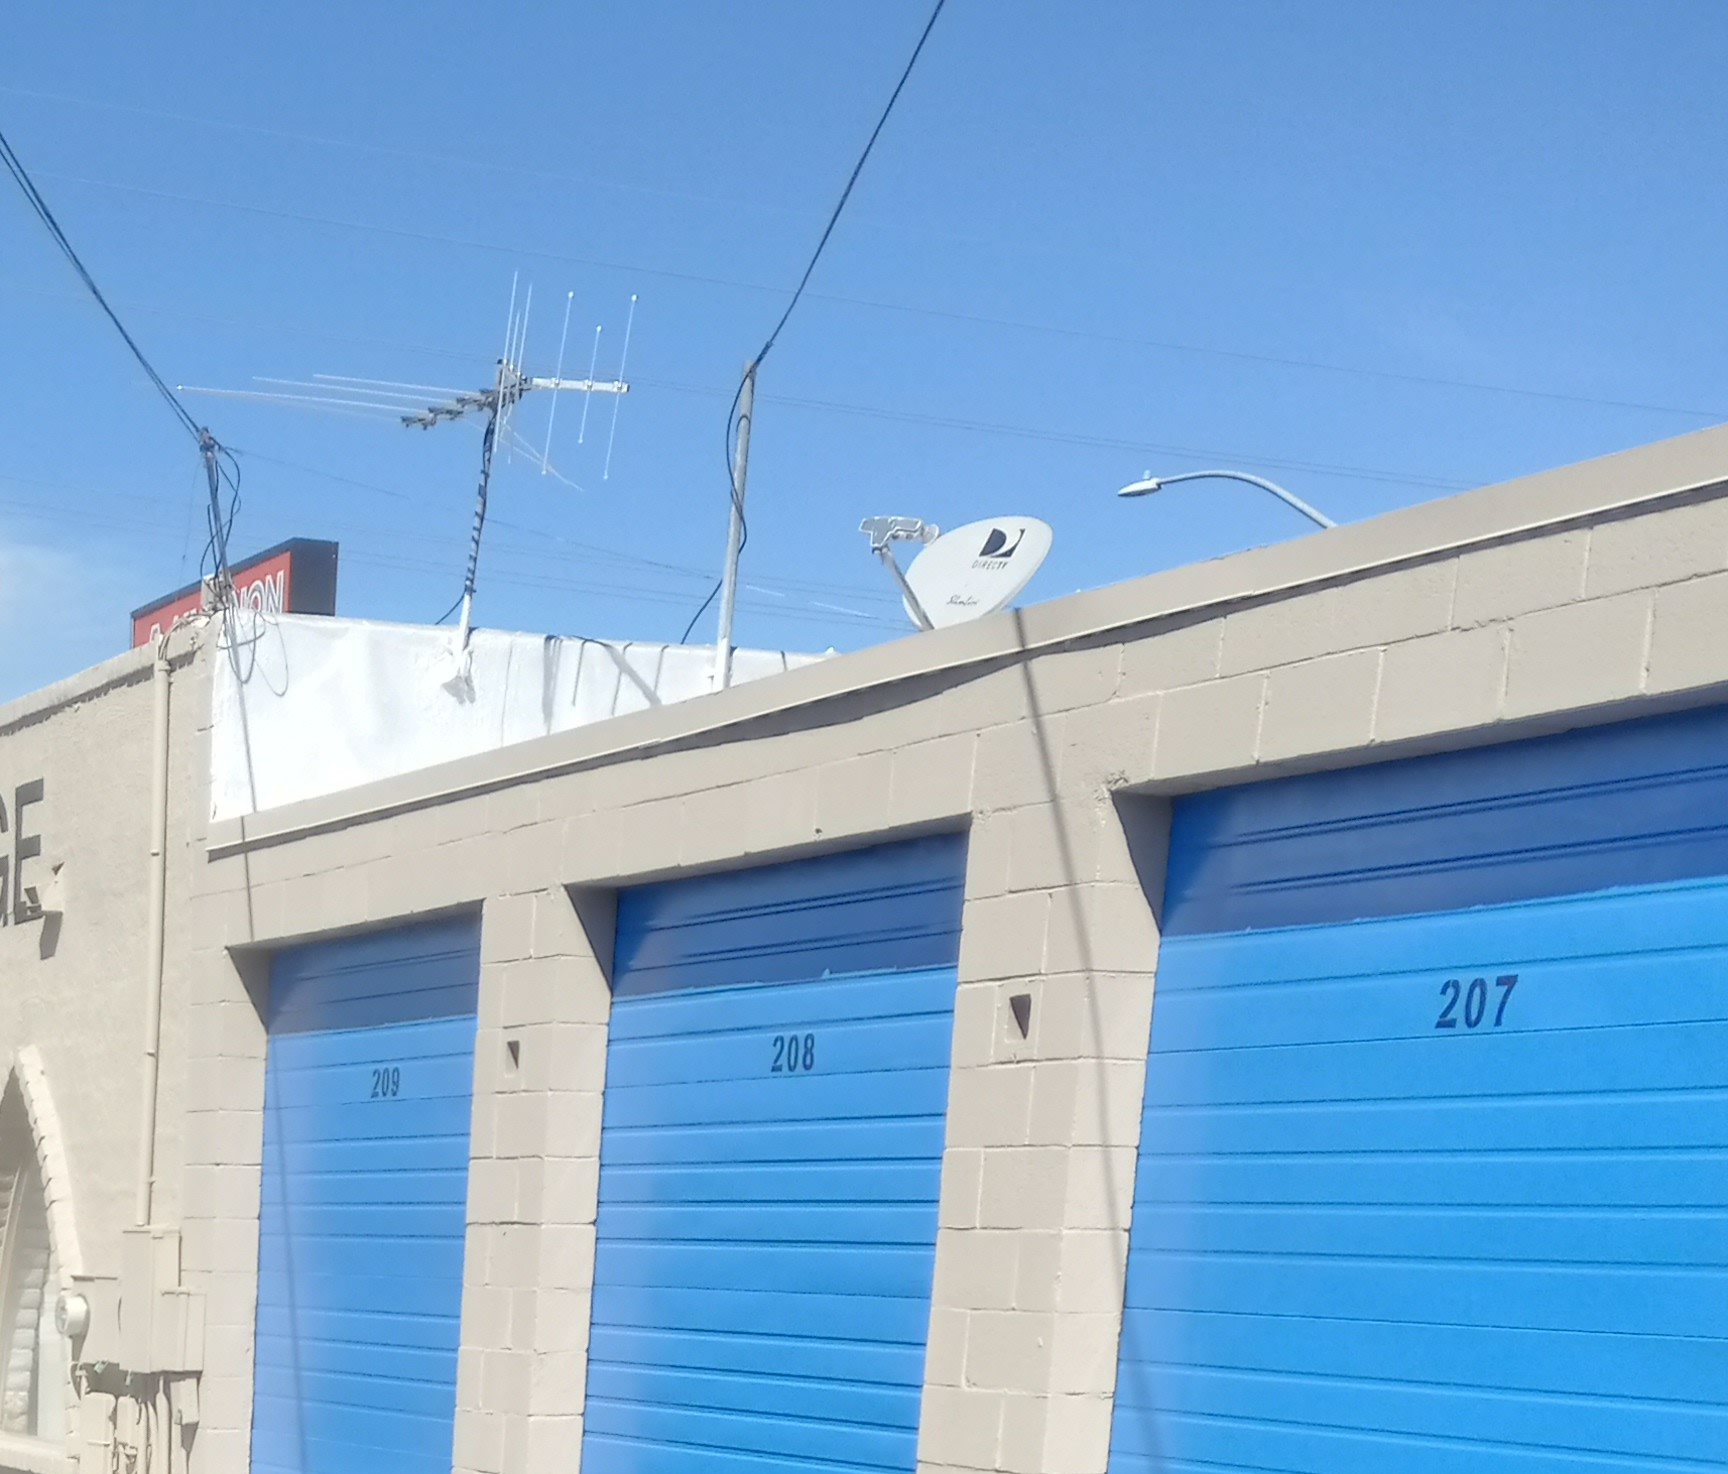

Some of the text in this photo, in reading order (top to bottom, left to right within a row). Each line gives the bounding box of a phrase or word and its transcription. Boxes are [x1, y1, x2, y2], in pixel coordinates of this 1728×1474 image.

[1434, 973, 1519, 1029] 207
[770, 1032, 815, 1072] 208
[370, 1066, 400, 1098] 209
